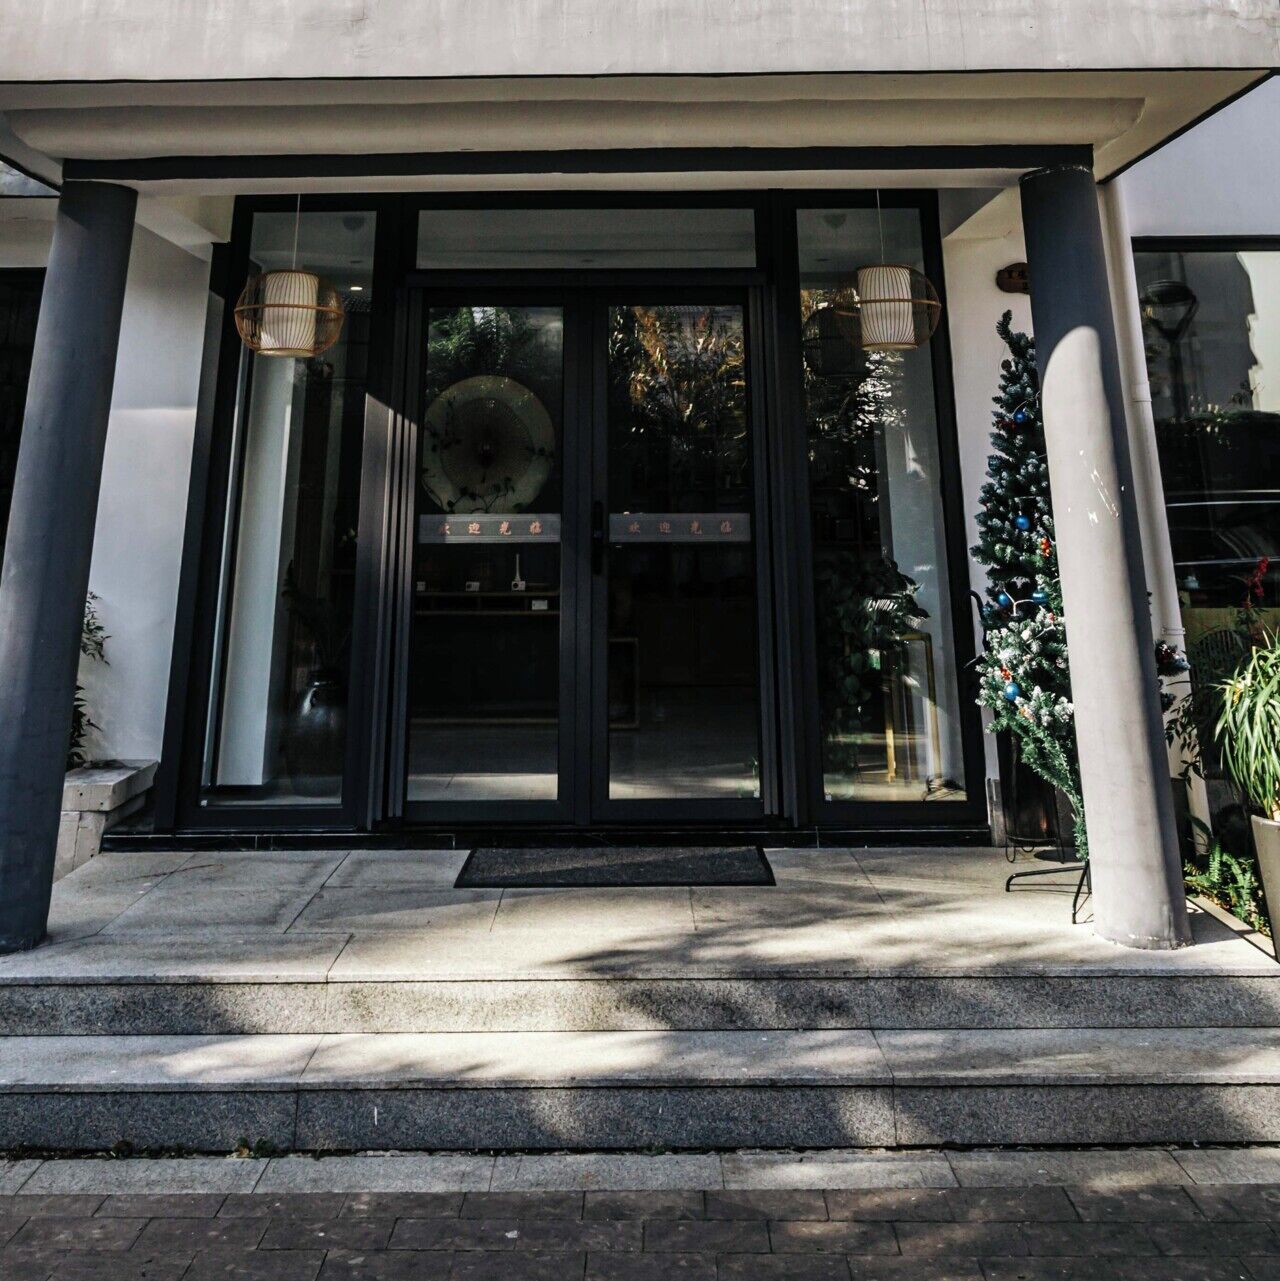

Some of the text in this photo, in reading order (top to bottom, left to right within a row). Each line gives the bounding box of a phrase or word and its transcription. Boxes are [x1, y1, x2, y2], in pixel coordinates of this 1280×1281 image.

[438, 520, 543, 535] 欢迎光临
[628, 520, 733, 535] 欢迎光临
